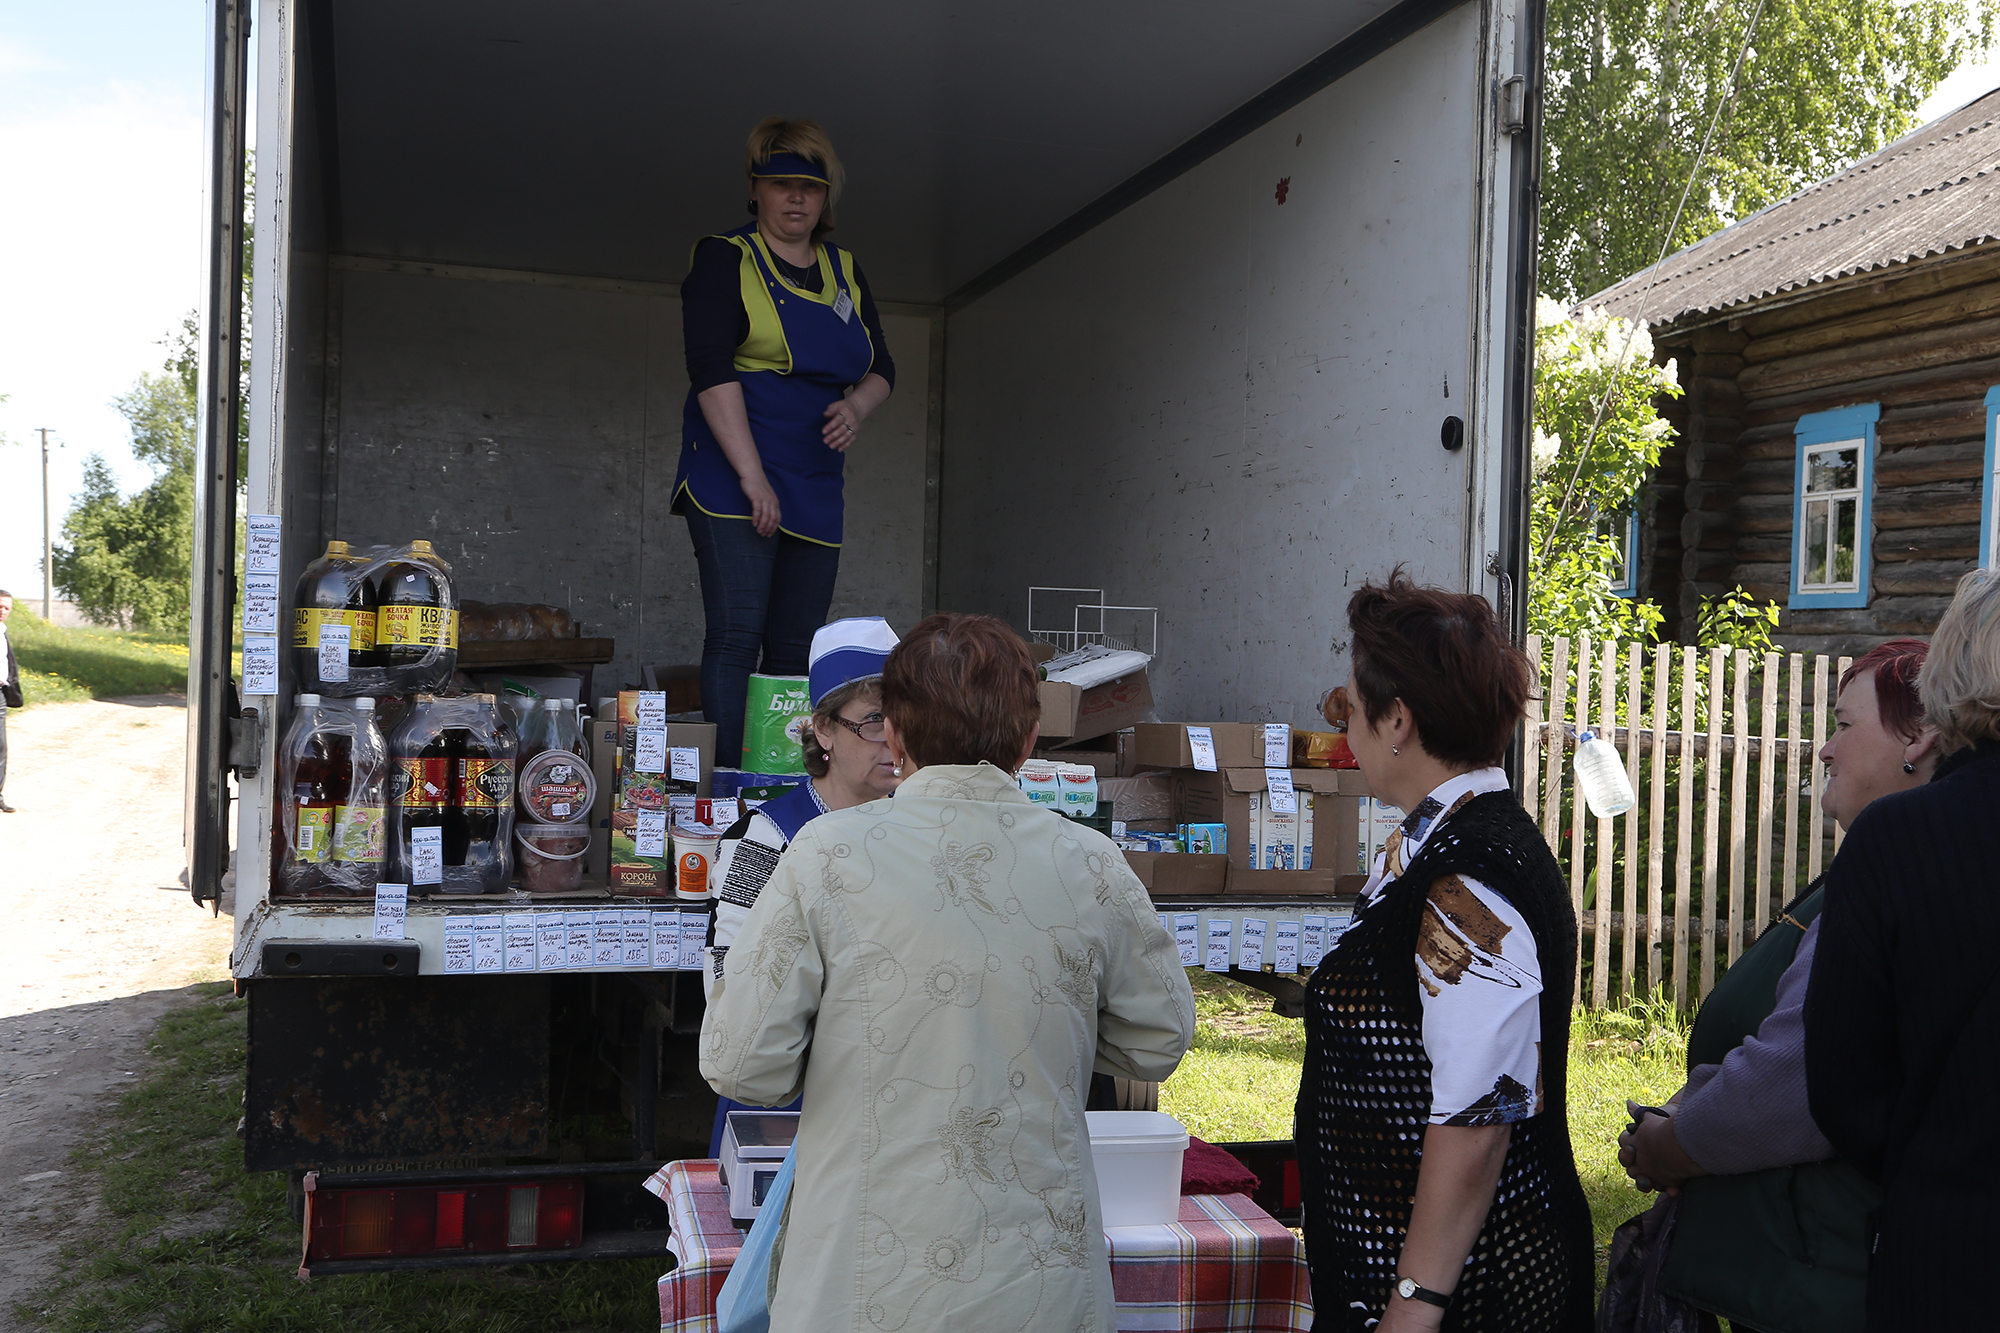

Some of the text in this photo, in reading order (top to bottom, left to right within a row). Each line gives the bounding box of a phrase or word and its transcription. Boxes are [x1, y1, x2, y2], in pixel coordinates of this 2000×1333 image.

[421, 608, 452, 625] КВАС
[620, 872, 657, 880] КОРОНА
[542, 954, 560, 966] 150-
[681, 952, 700, 965] 110-
